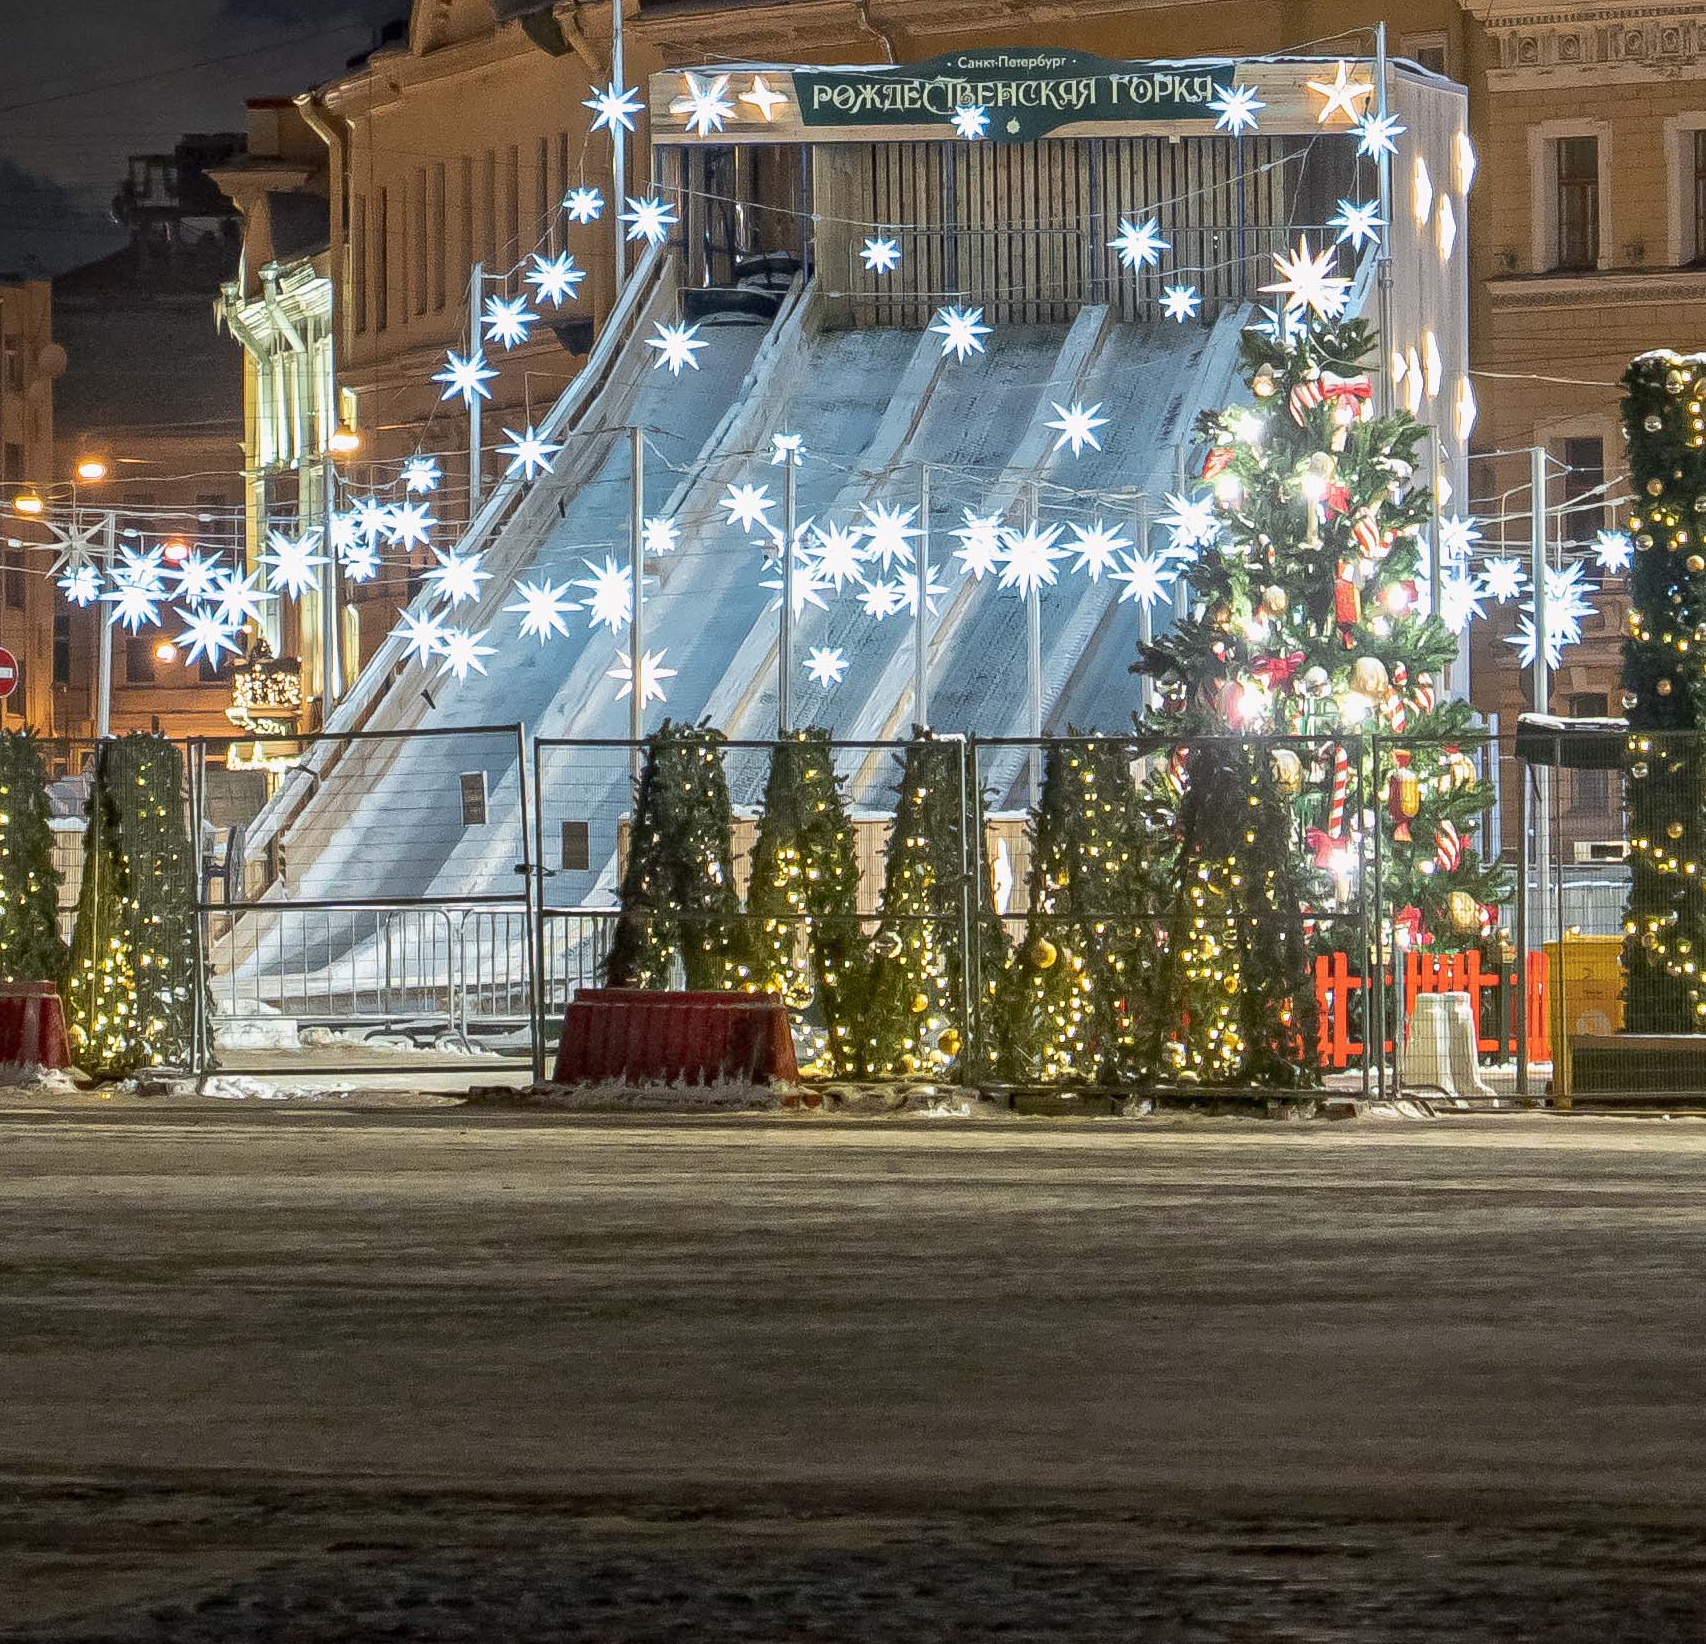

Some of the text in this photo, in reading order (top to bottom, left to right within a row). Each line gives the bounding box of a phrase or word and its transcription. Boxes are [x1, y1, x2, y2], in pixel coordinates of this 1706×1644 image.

[956, 53, 1067, 70] Санкт-Петербург
[812, 74, 1213, 115] РОЖДЕСТВЕНСКАЯ ГОРКА
